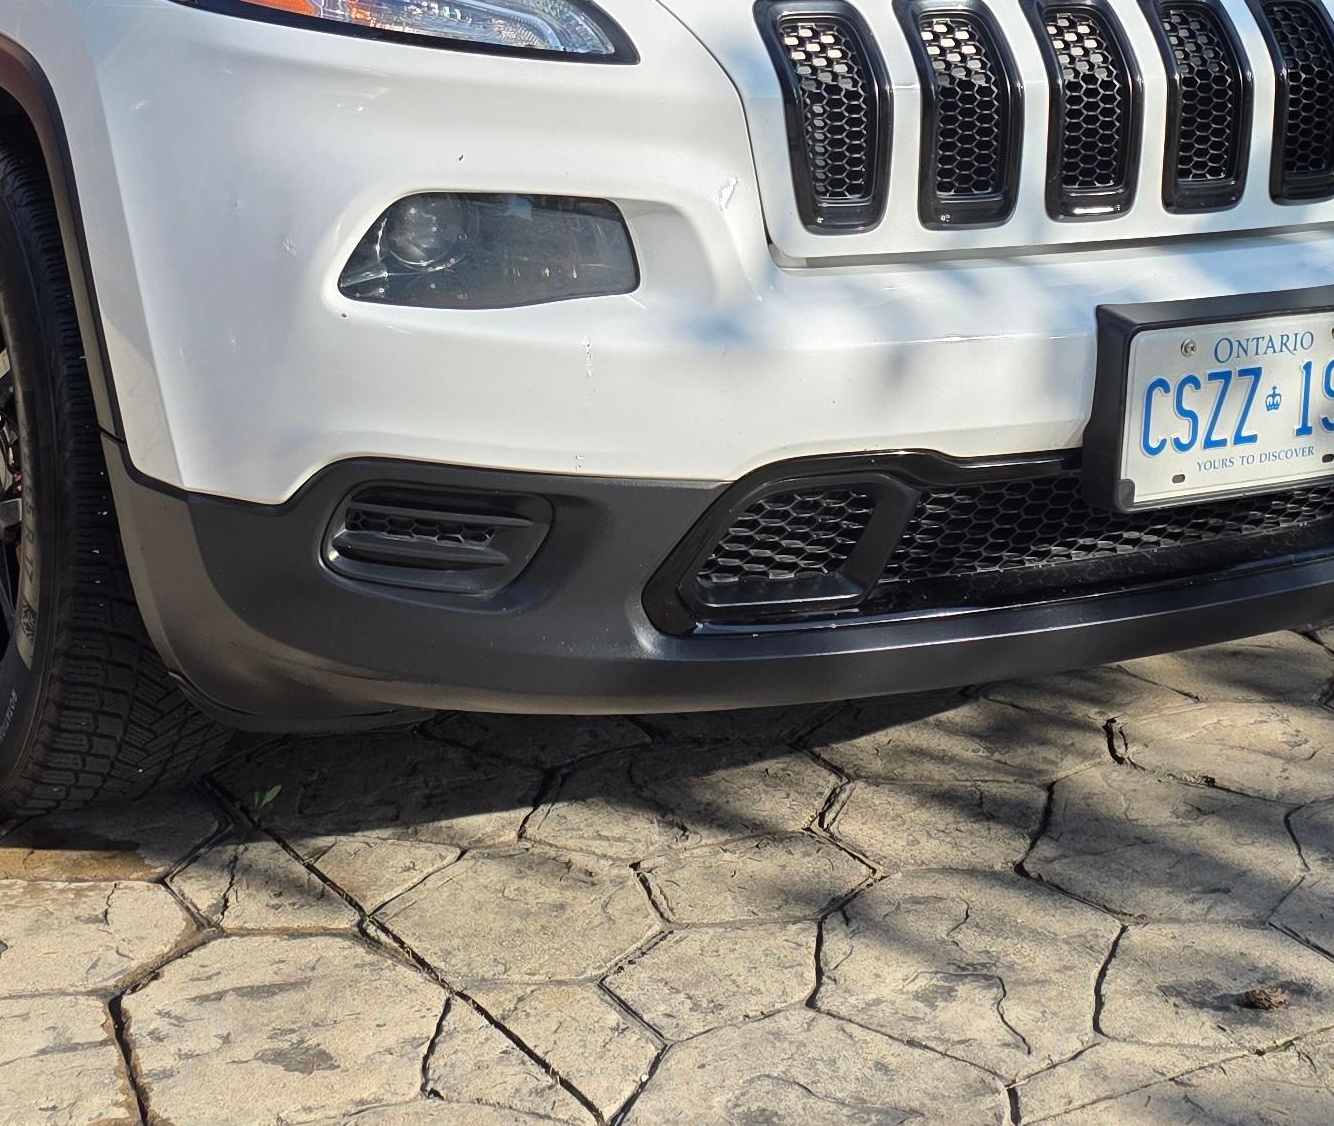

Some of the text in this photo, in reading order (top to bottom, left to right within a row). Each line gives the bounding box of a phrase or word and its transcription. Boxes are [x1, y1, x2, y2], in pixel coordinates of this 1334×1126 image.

[1213, 330, 1314, 363] ONTARIO
[1141, 366, 1263, 457] CSZZ
[1196, 445, 1315, 472] YOURS TO DISCOVER
